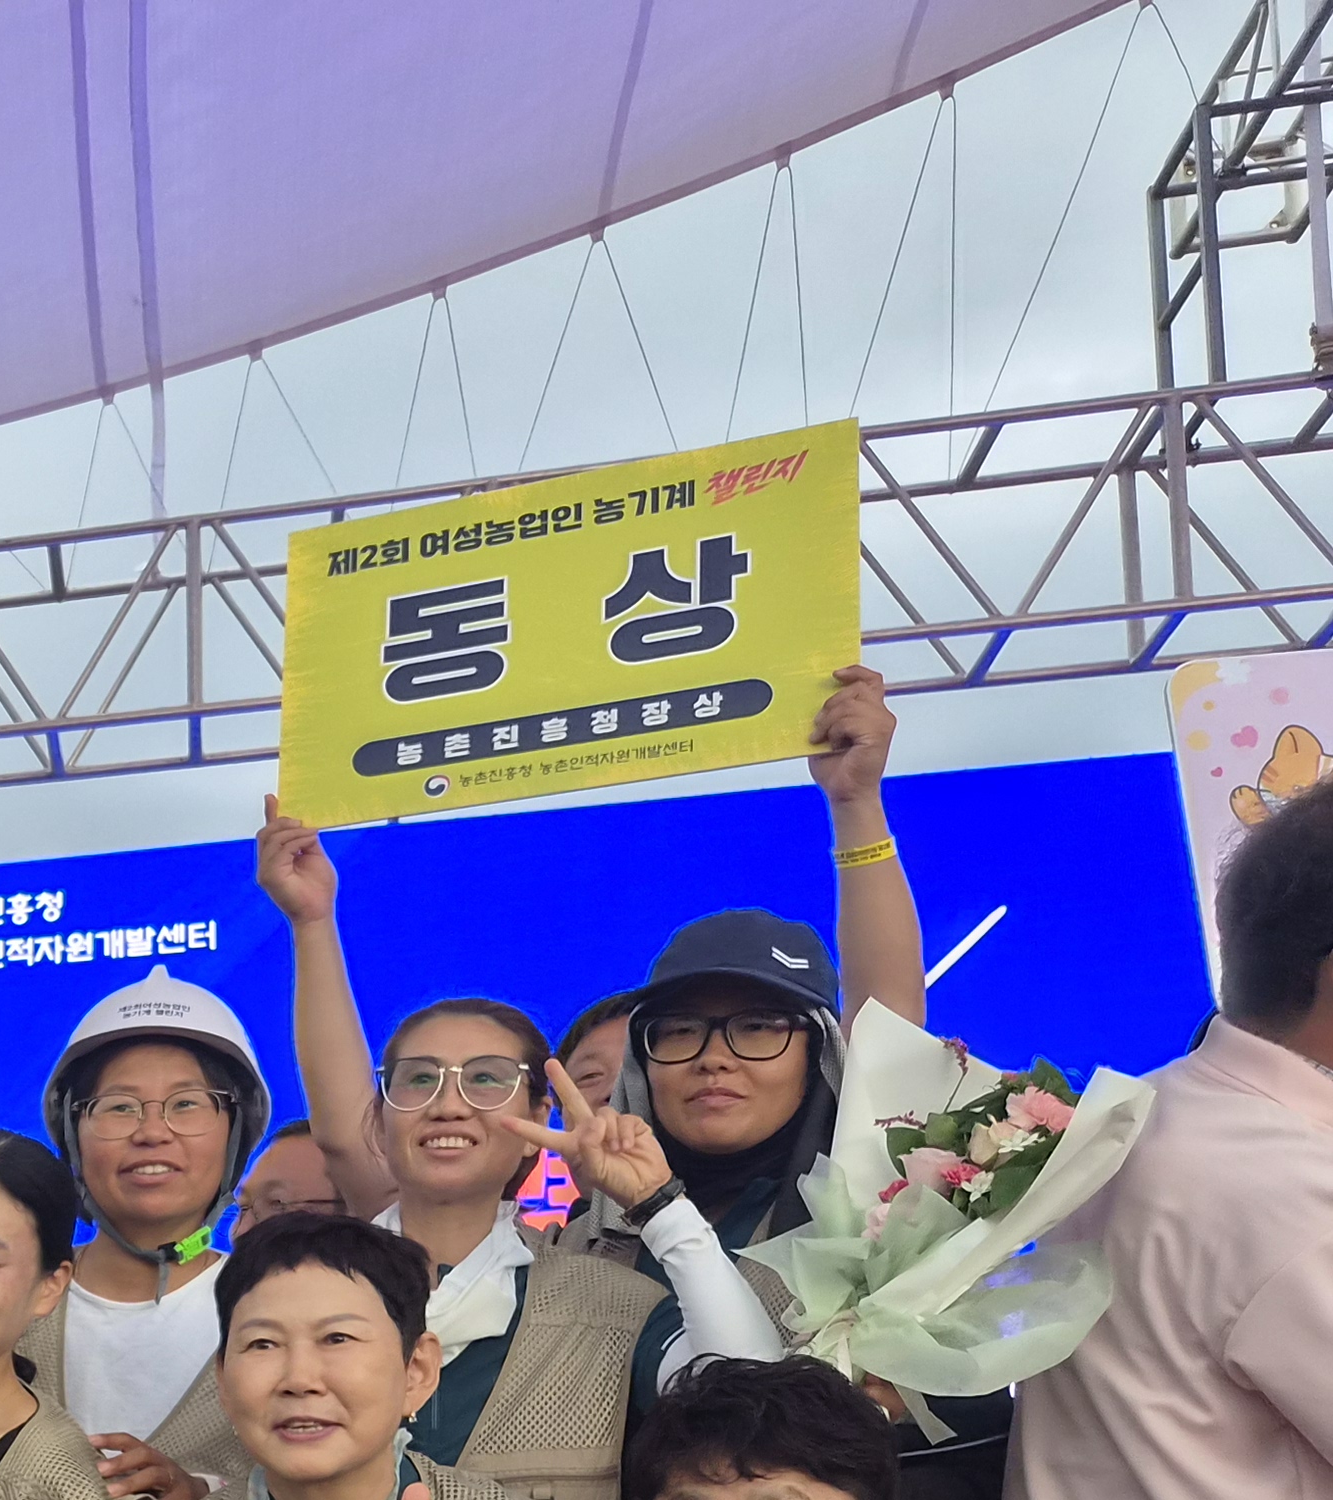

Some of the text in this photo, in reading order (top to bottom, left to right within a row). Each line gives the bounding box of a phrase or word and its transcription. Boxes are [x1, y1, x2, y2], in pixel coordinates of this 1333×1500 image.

[327, 449, 810, 577] 제2회 여성농업인 농기계 챌린지
[459, 737, 695, 788] 농촌진흥청 농촌인적자원개발센터
